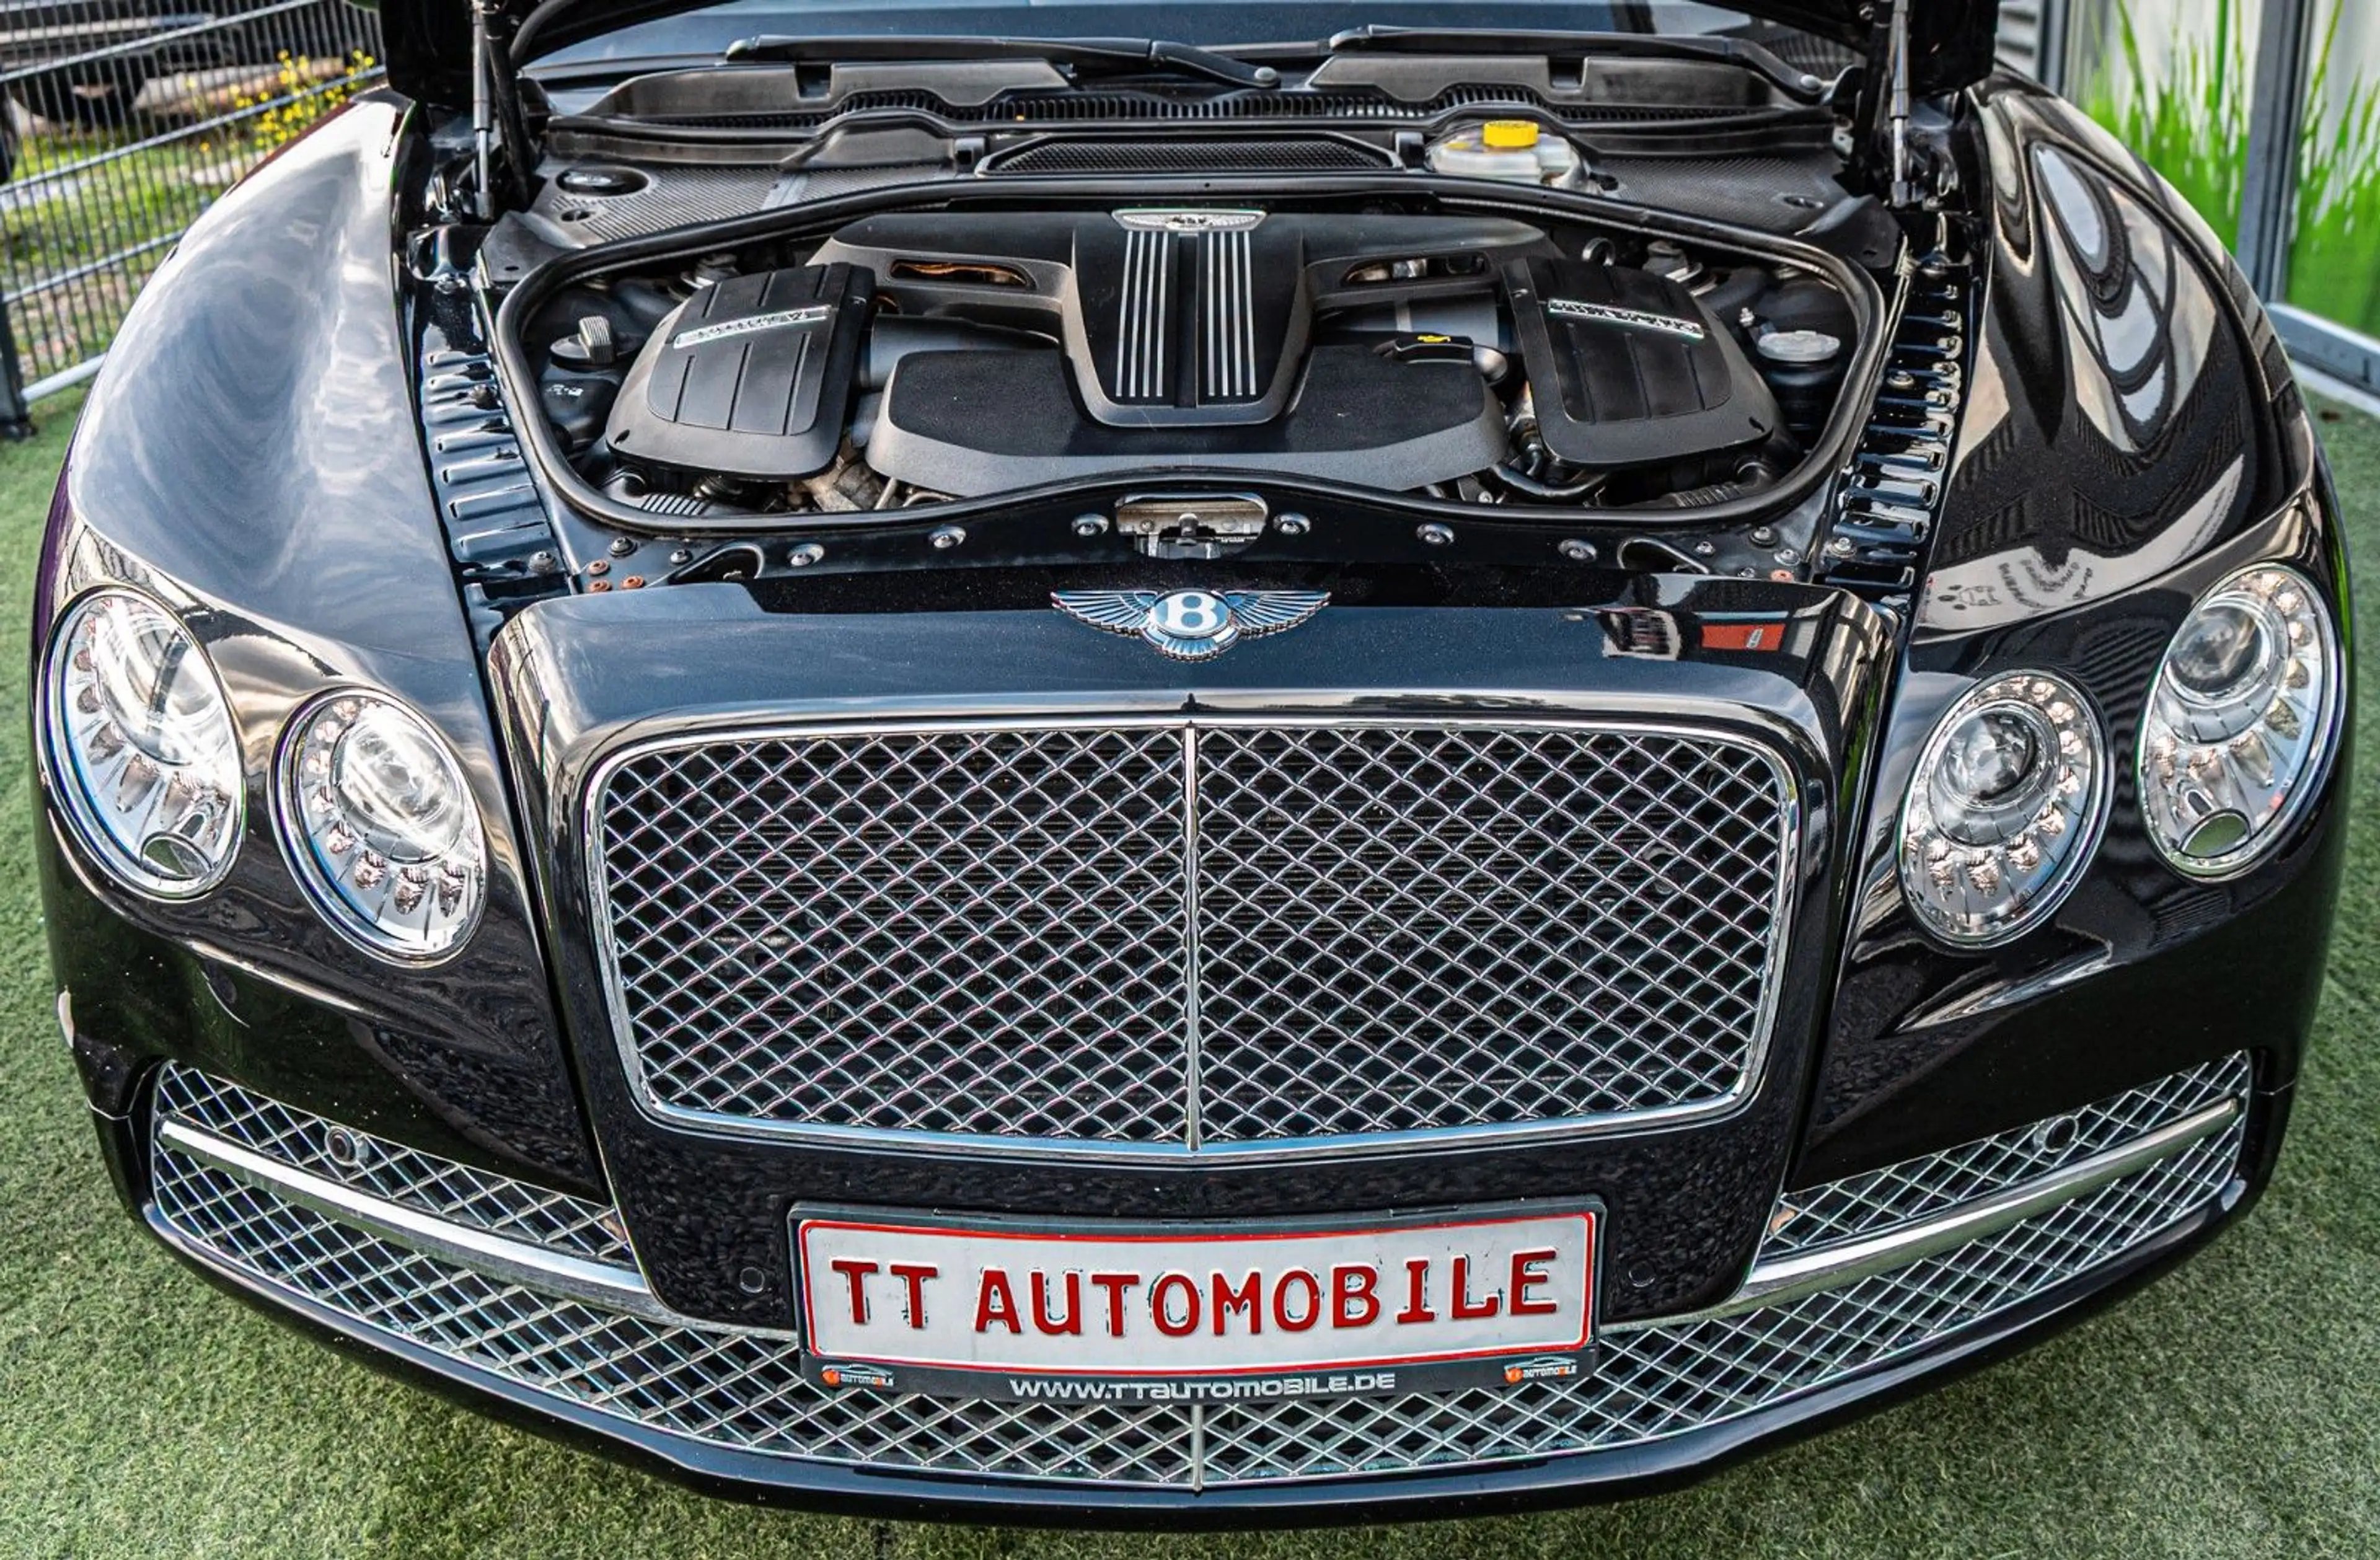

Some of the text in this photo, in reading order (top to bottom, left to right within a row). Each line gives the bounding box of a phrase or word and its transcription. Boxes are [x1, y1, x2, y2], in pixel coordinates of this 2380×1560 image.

[1166, 591, 1217, 632] B
[831, 1248, 1558, 1337] TT AUTOMOBILE
